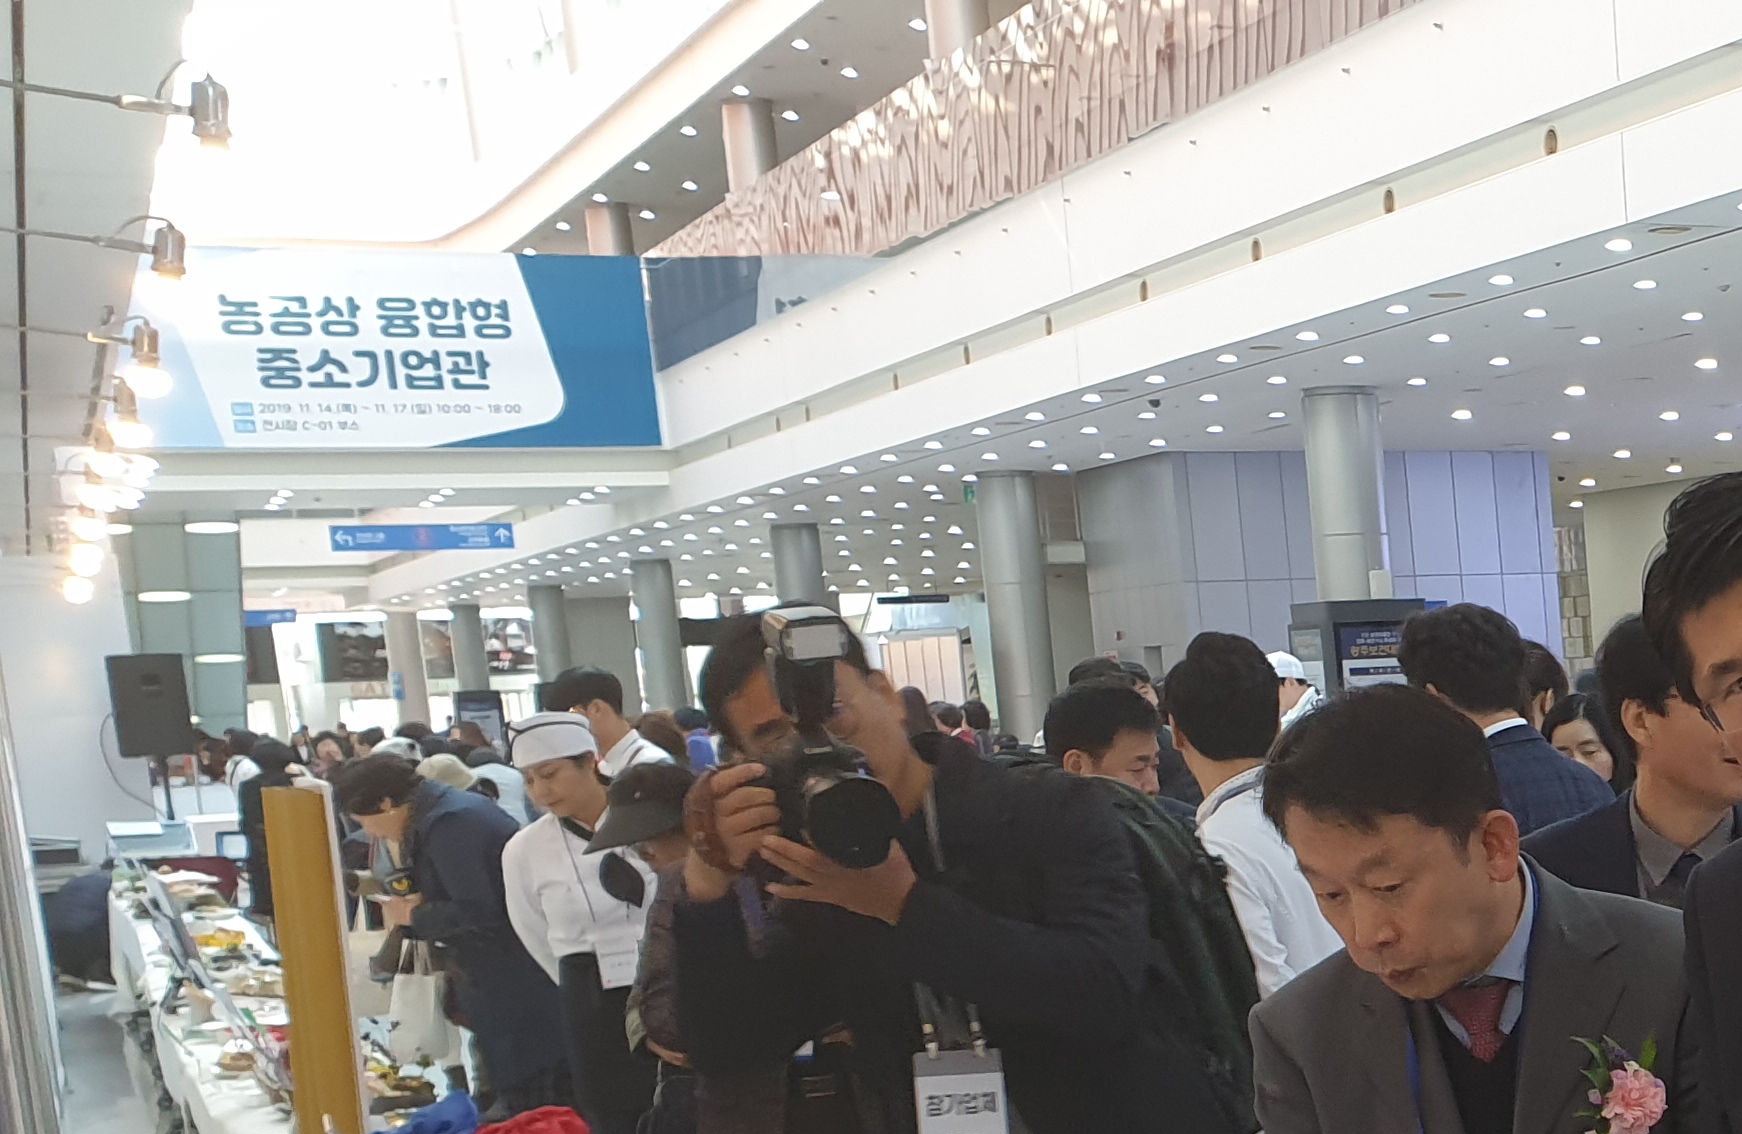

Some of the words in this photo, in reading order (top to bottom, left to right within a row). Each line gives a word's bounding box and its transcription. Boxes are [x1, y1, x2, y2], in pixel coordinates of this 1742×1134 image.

[217, 293, 361, 337] 농공상
[375, 296, 512, 340] 융합형
[256, 347, 491, 390] 중소기업관
